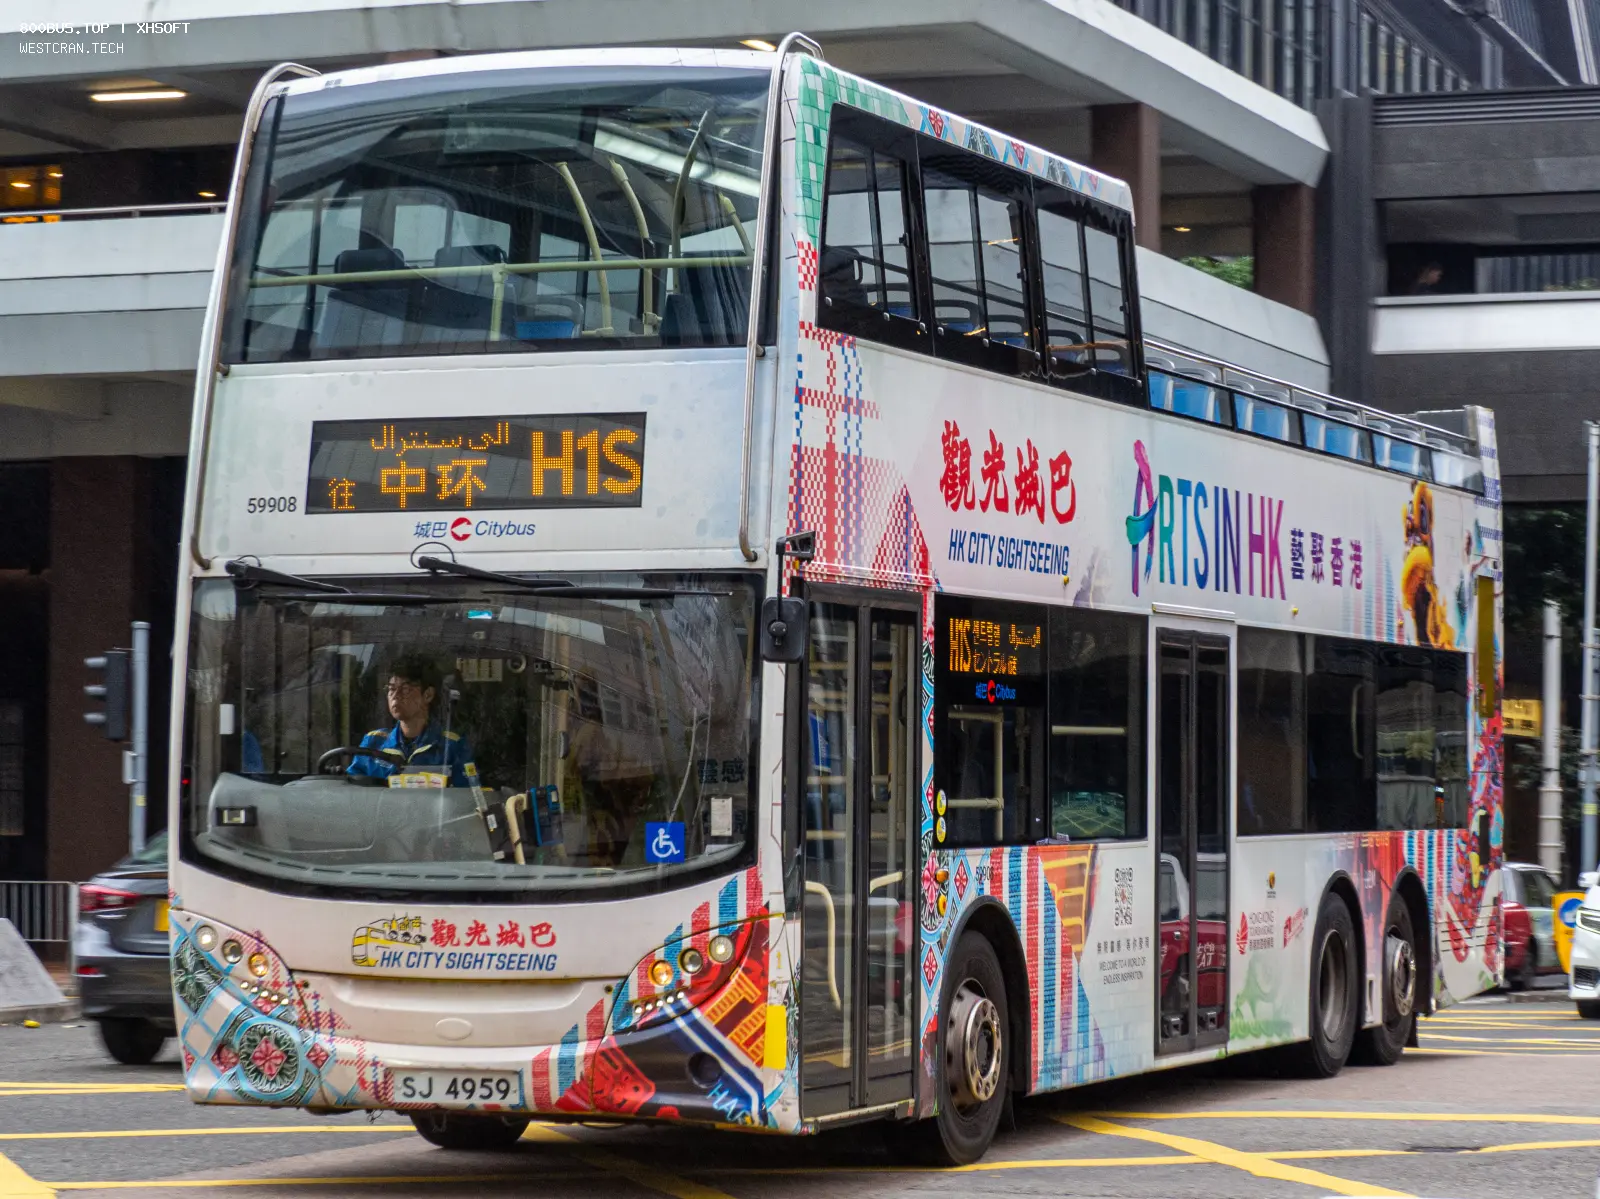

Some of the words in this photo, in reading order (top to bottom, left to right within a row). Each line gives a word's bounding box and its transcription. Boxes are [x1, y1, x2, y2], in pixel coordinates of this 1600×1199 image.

[530, 428, 642, 497] H1S
[939, 419, 1077, 525] 觀光城巴
[327, 476, 356, 510] 往
[380, 459, 488, 509] 中环
[247, 496, 297, 514] 59908
[413, 520, 447, 539] 城巴
[474, 519, 536, 539] Citybus
[1213, 485, 1241, 595] IN
[1247, 492, 1287, 601] HK
[948, 528, 967, 562] HK
[967, 531, 996, 566] CITY
[996, 535, 1070, 576] SIGHTSEEING
[429, 917, 558, 949] 觀光城巴
[379, 950, 402, 969] HK
[406, 951, 446, 970] CITY
[446, 952, 558, 972] SIGHTSEEING
[402, 1076, 433, 1099] SJ
[445, 1076, 511, 1101] 4959
